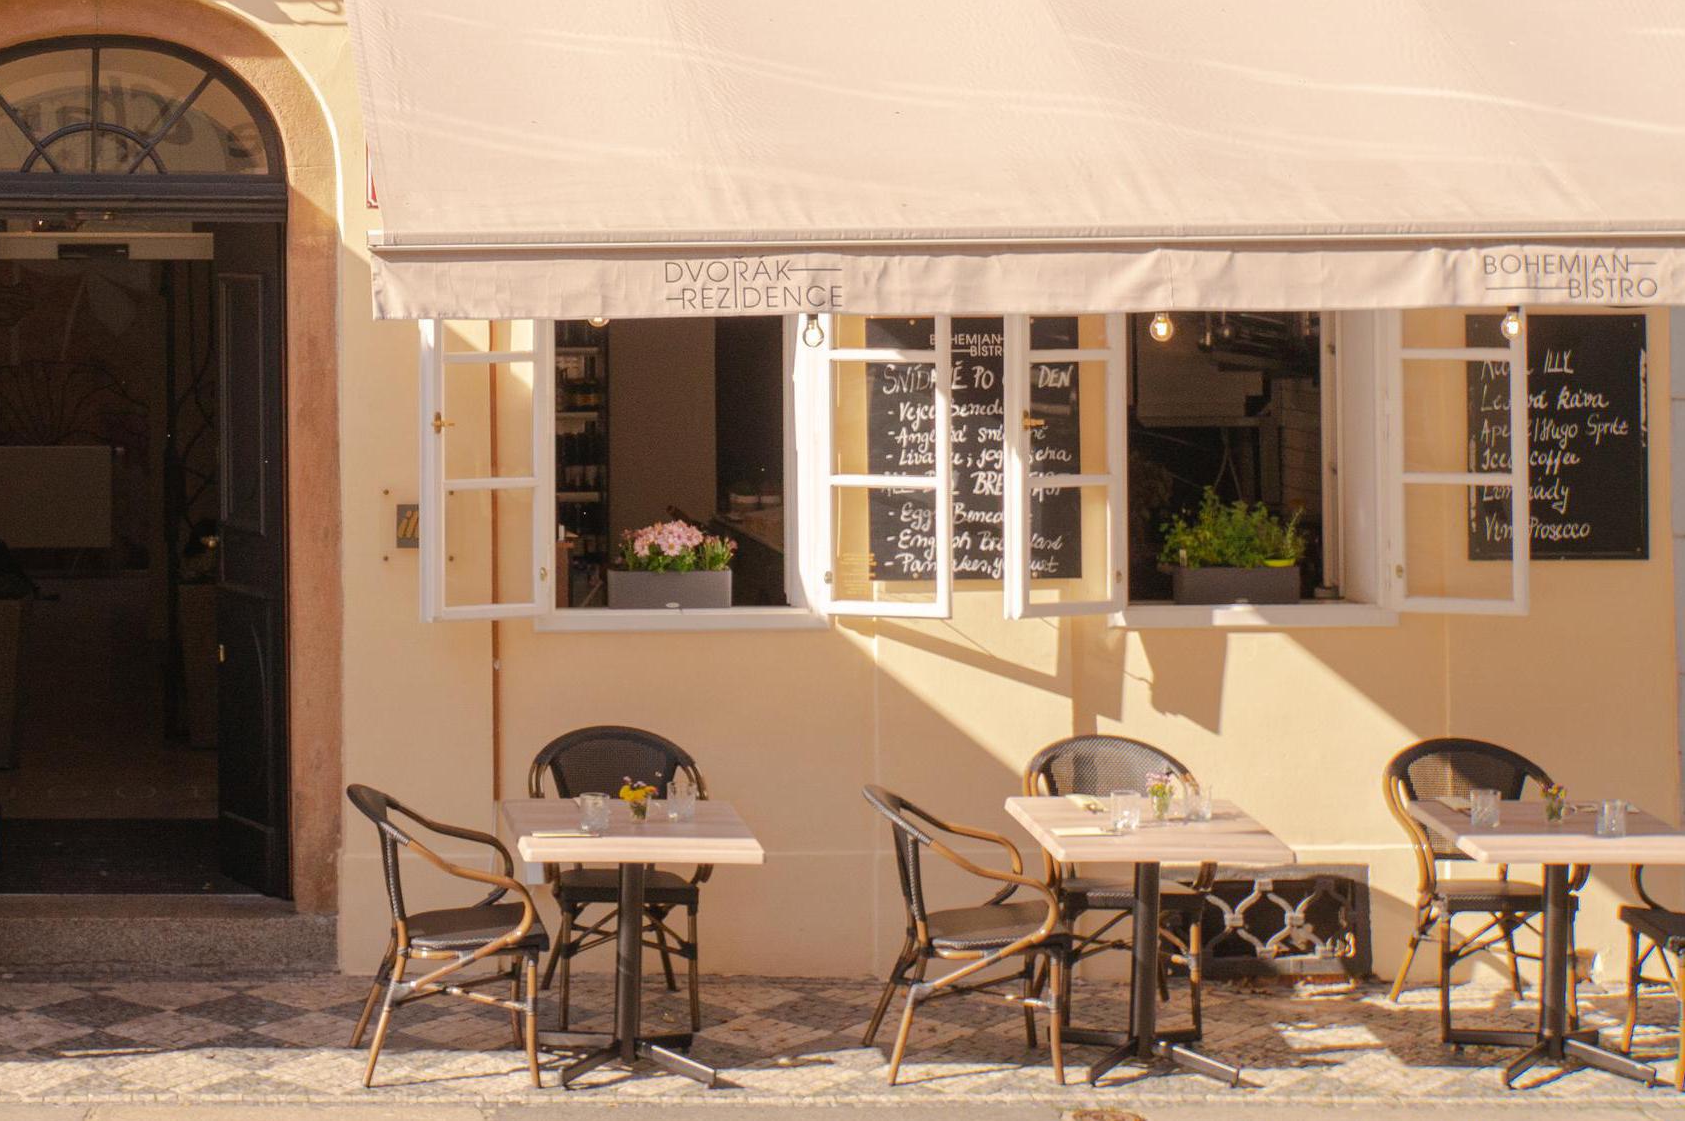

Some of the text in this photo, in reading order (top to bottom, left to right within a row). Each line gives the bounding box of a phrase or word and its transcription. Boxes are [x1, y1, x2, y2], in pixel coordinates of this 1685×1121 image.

[1483, 254, 1630, 275] BOHEMIAN
[681, 285, 843, 310] REZIDENCE
[1568, 278, 1658, 299] BISTRO
[929, 333, 1001, 345] BHEMIAN
[970, 345, 1003, 357] BISTR
[972, 366, 994, 390] PO
[1038, 365, 1074, 388] DEN
[1530, 449, 1581, 475] coffee
[900, 502, 936, 531] Egg
